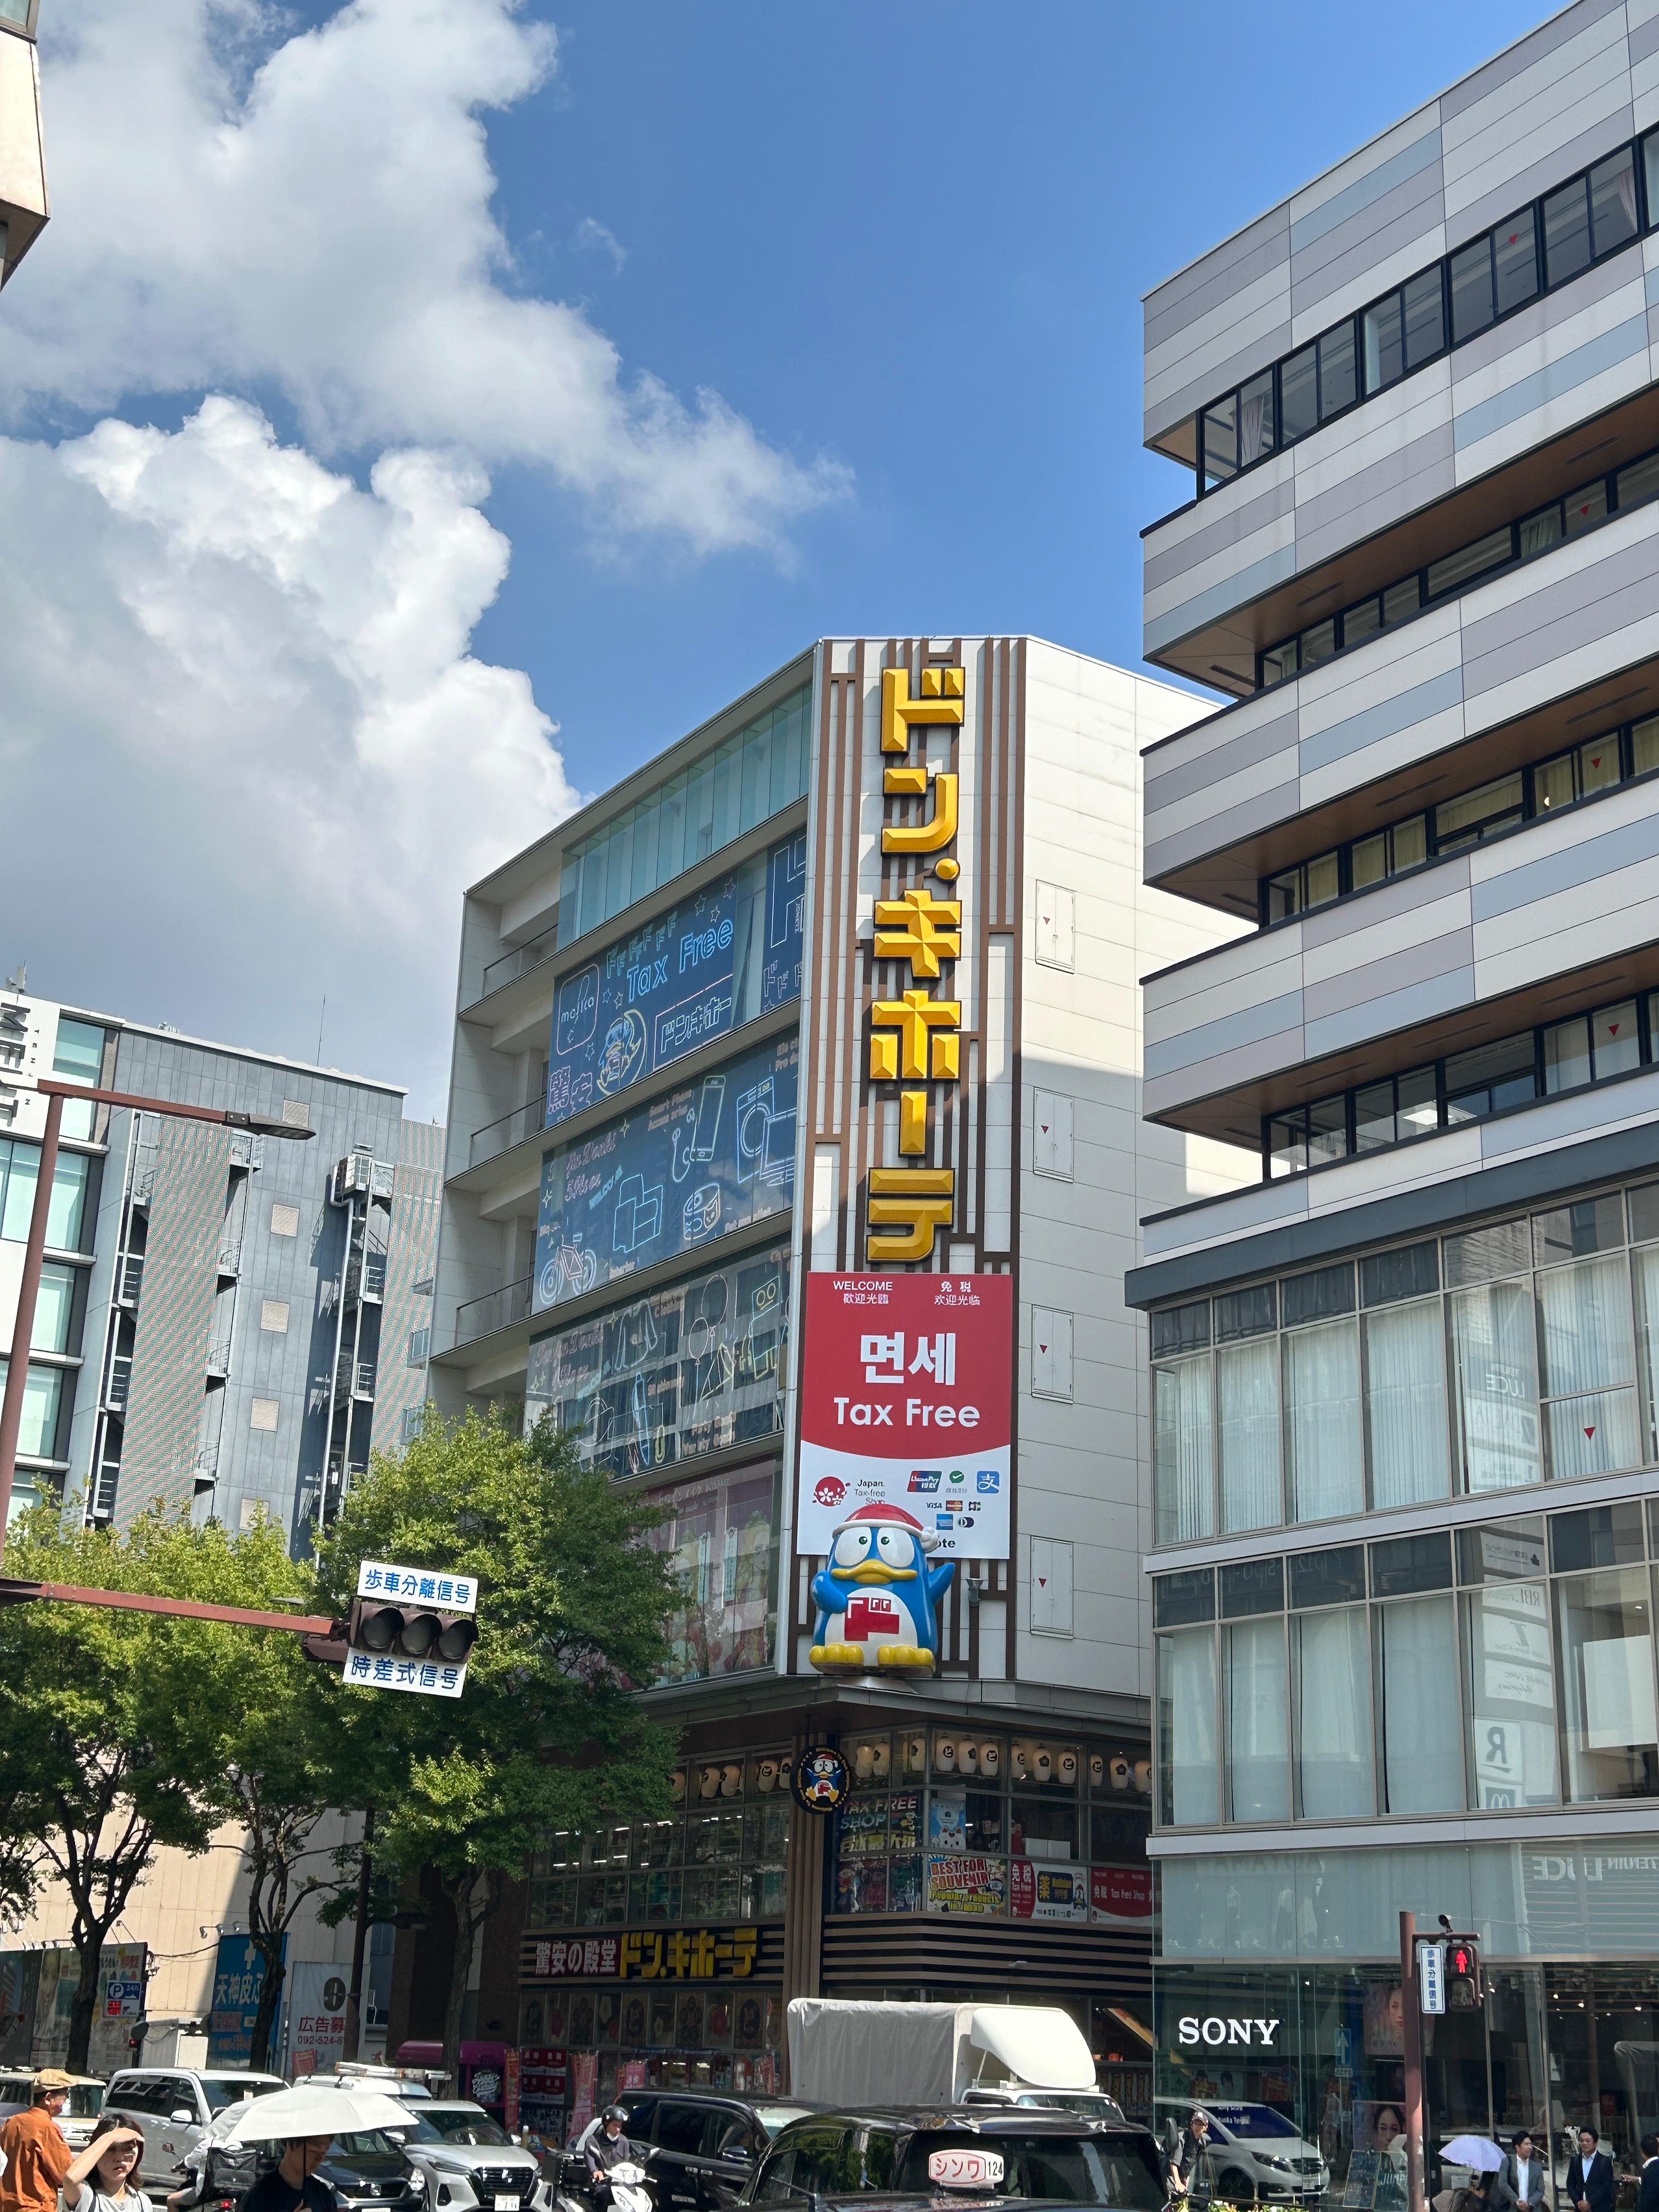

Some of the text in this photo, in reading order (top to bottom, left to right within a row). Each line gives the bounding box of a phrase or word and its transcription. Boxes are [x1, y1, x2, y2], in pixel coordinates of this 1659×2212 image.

[627, 919, 733, 1002] Tax Free
[833, 1280, 893, 1292] WELCOME
[860, 1331, 956, 1386] 면세
[833, 1397, 981, 1427] Tax Free
[365, 1568, 471, 1604] 歩車分離信号
[351, 1655, 459, 1689] 時差式信号
[843, 1795, 918, 1815] TAX FREE
[840, 1813, 887, 1830] SHOP
[930, 1858, 985, 1876] BEST FOR
[930, 1872, 989, 1891] SOUVENIR
[535, 1939, 617, 1974] 驚安の殿堂
[1179, 2017, 1279, 2045] SONY
[936, 2158, 979, 2179] シンワ
[988, 2161, 1003, 2176] 124
